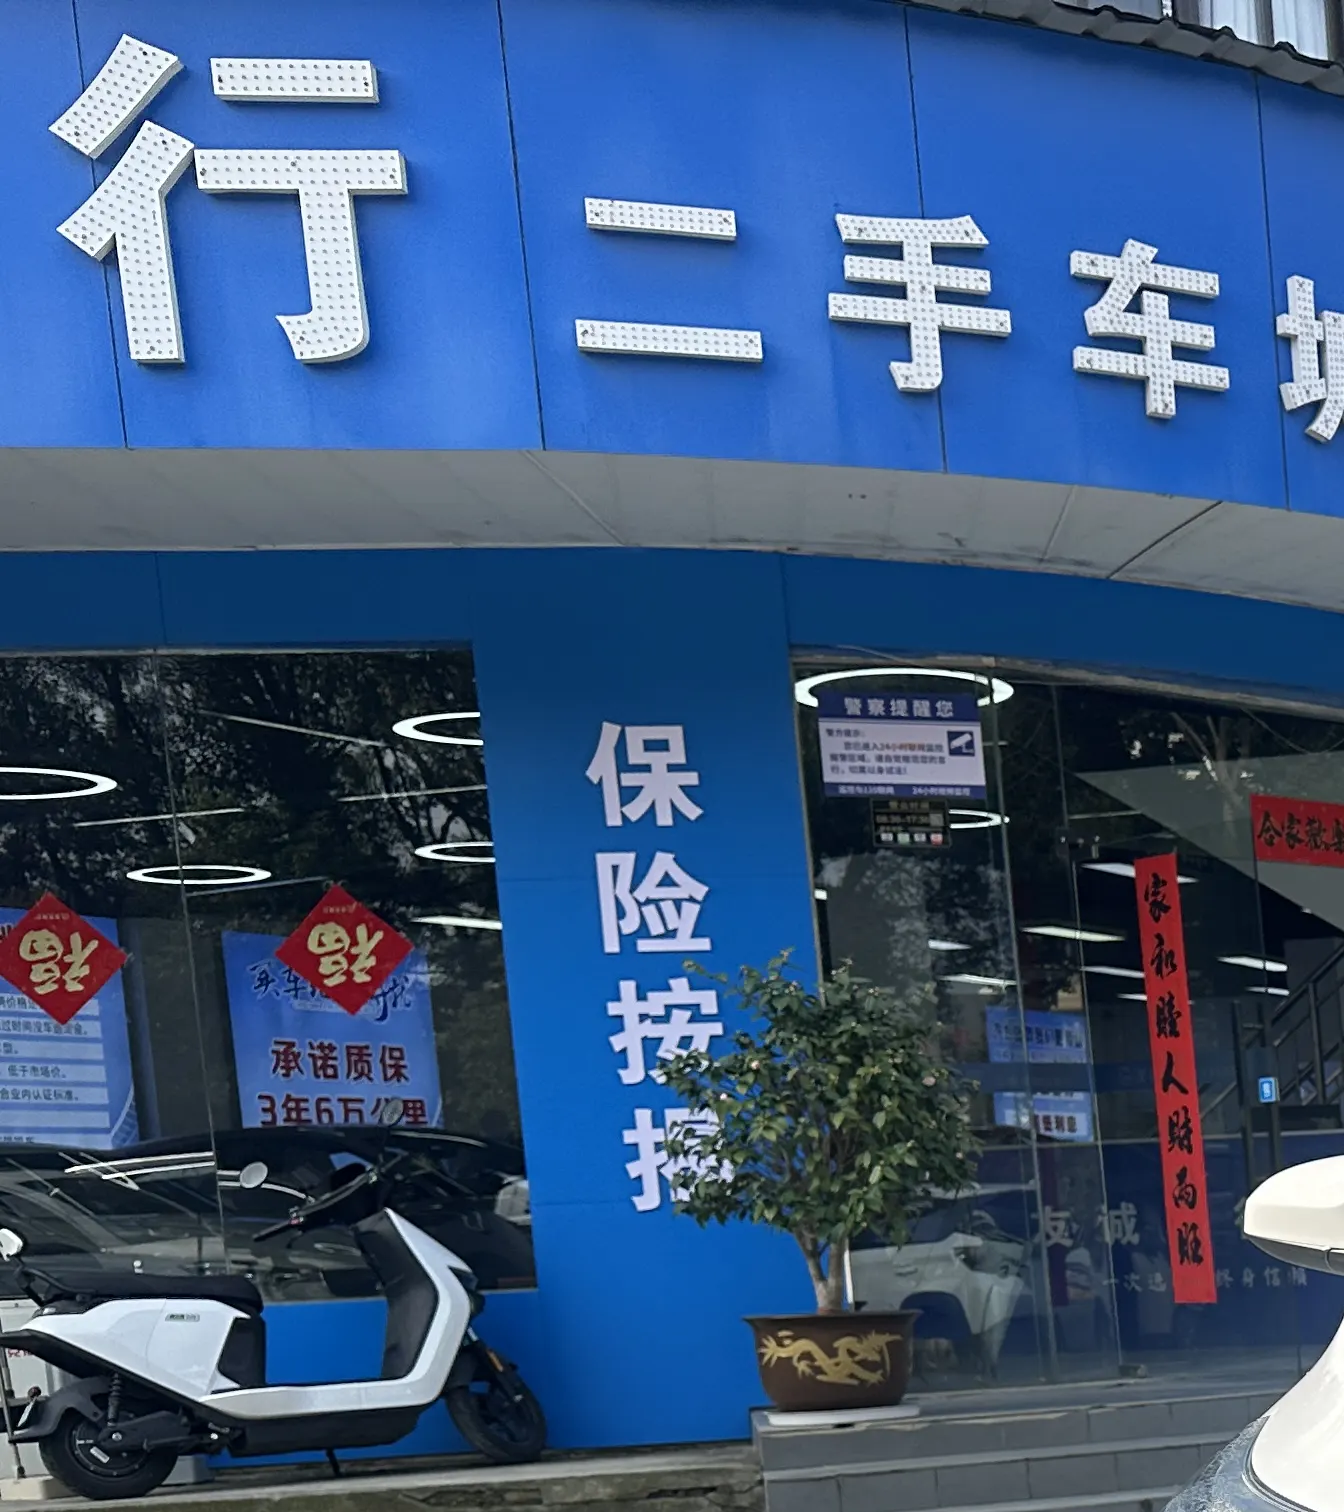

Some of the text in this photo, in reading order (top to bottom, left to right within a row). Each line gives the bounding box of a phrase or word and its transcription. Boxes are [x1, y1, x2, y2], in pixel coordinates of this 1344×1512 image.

[844, 697, 954, 717] 警察提醒您
[271, 1038, 410, 1084] 承诺质保
